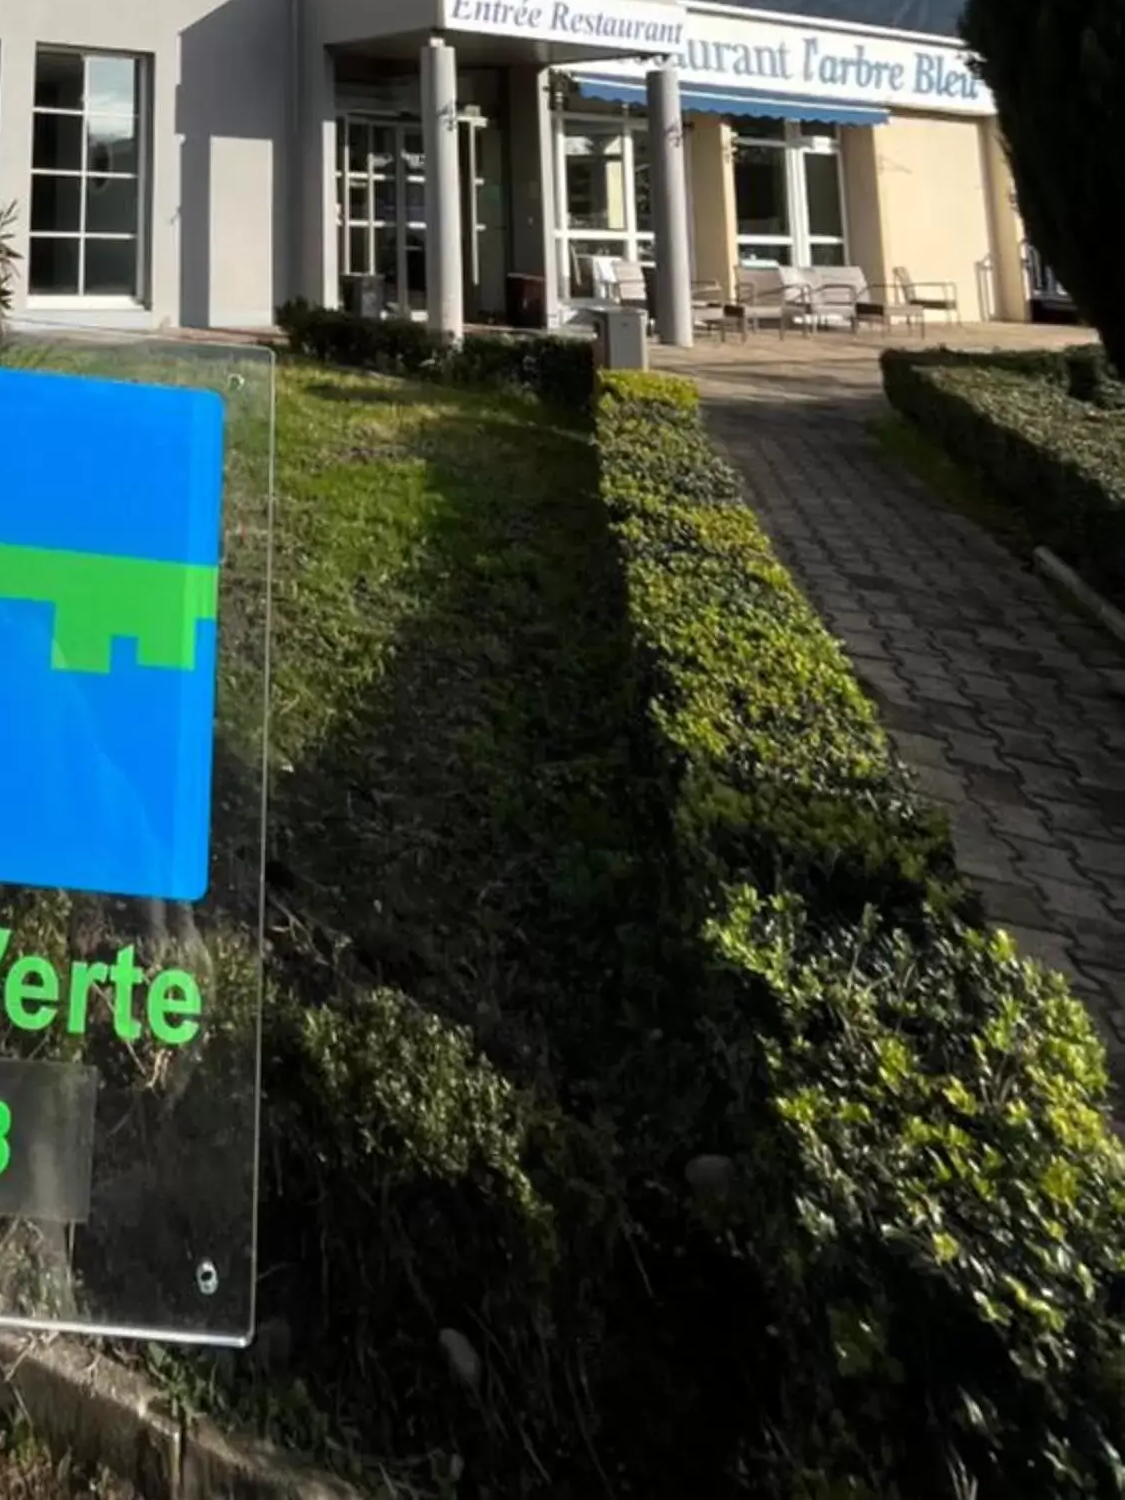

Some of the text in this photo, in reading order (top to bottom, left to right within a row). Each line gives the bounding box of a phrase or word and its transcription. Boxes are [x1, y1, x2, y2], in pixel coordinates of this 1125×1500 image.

[550, 0, 684, 45] Restaurant
[803, 36, 905, 91] l'arbre
[912, 50, 981, 101] Bleu
